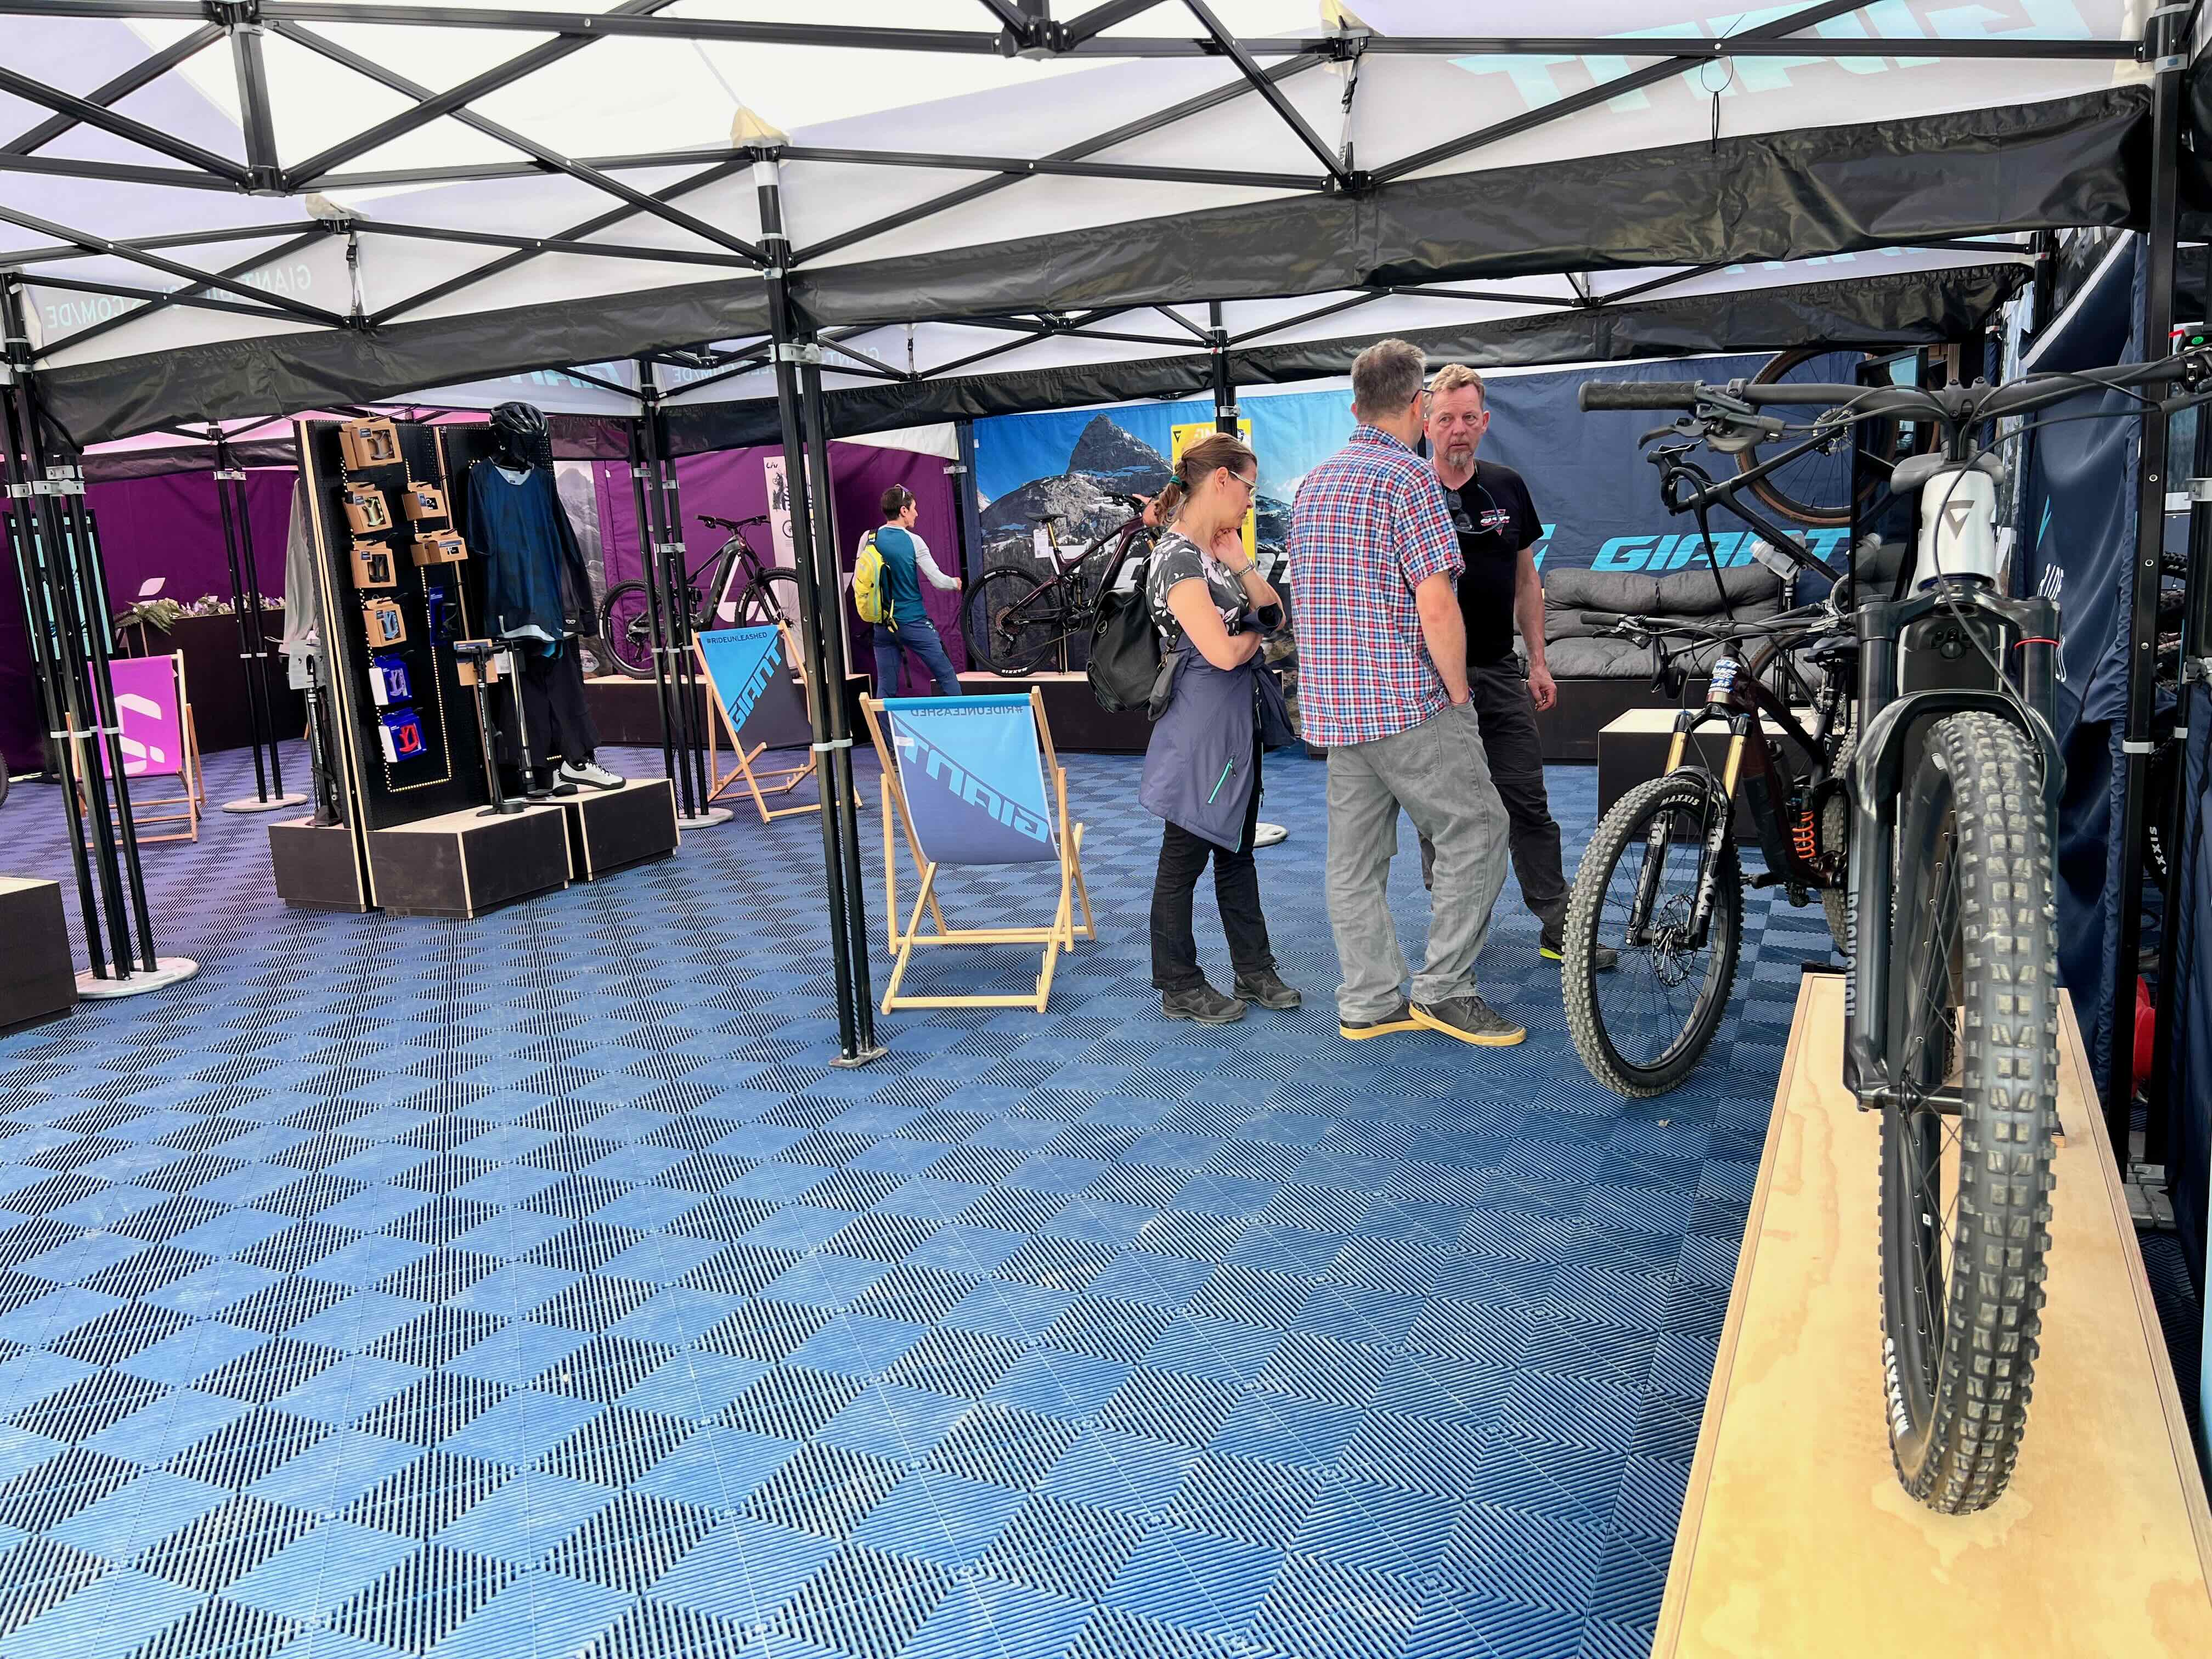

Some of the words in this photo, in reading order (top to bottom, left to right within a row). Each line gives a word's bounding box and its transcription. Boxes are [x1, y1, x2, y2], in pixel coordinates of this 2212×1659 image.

[707, 631, 768, 645] #RIDEUNLEASHED
[727, 635, 782, 733] GIANT
[1660, 794, 1700, 809] MAXXIS
[2149, 826, 2166, 874] XXIS
